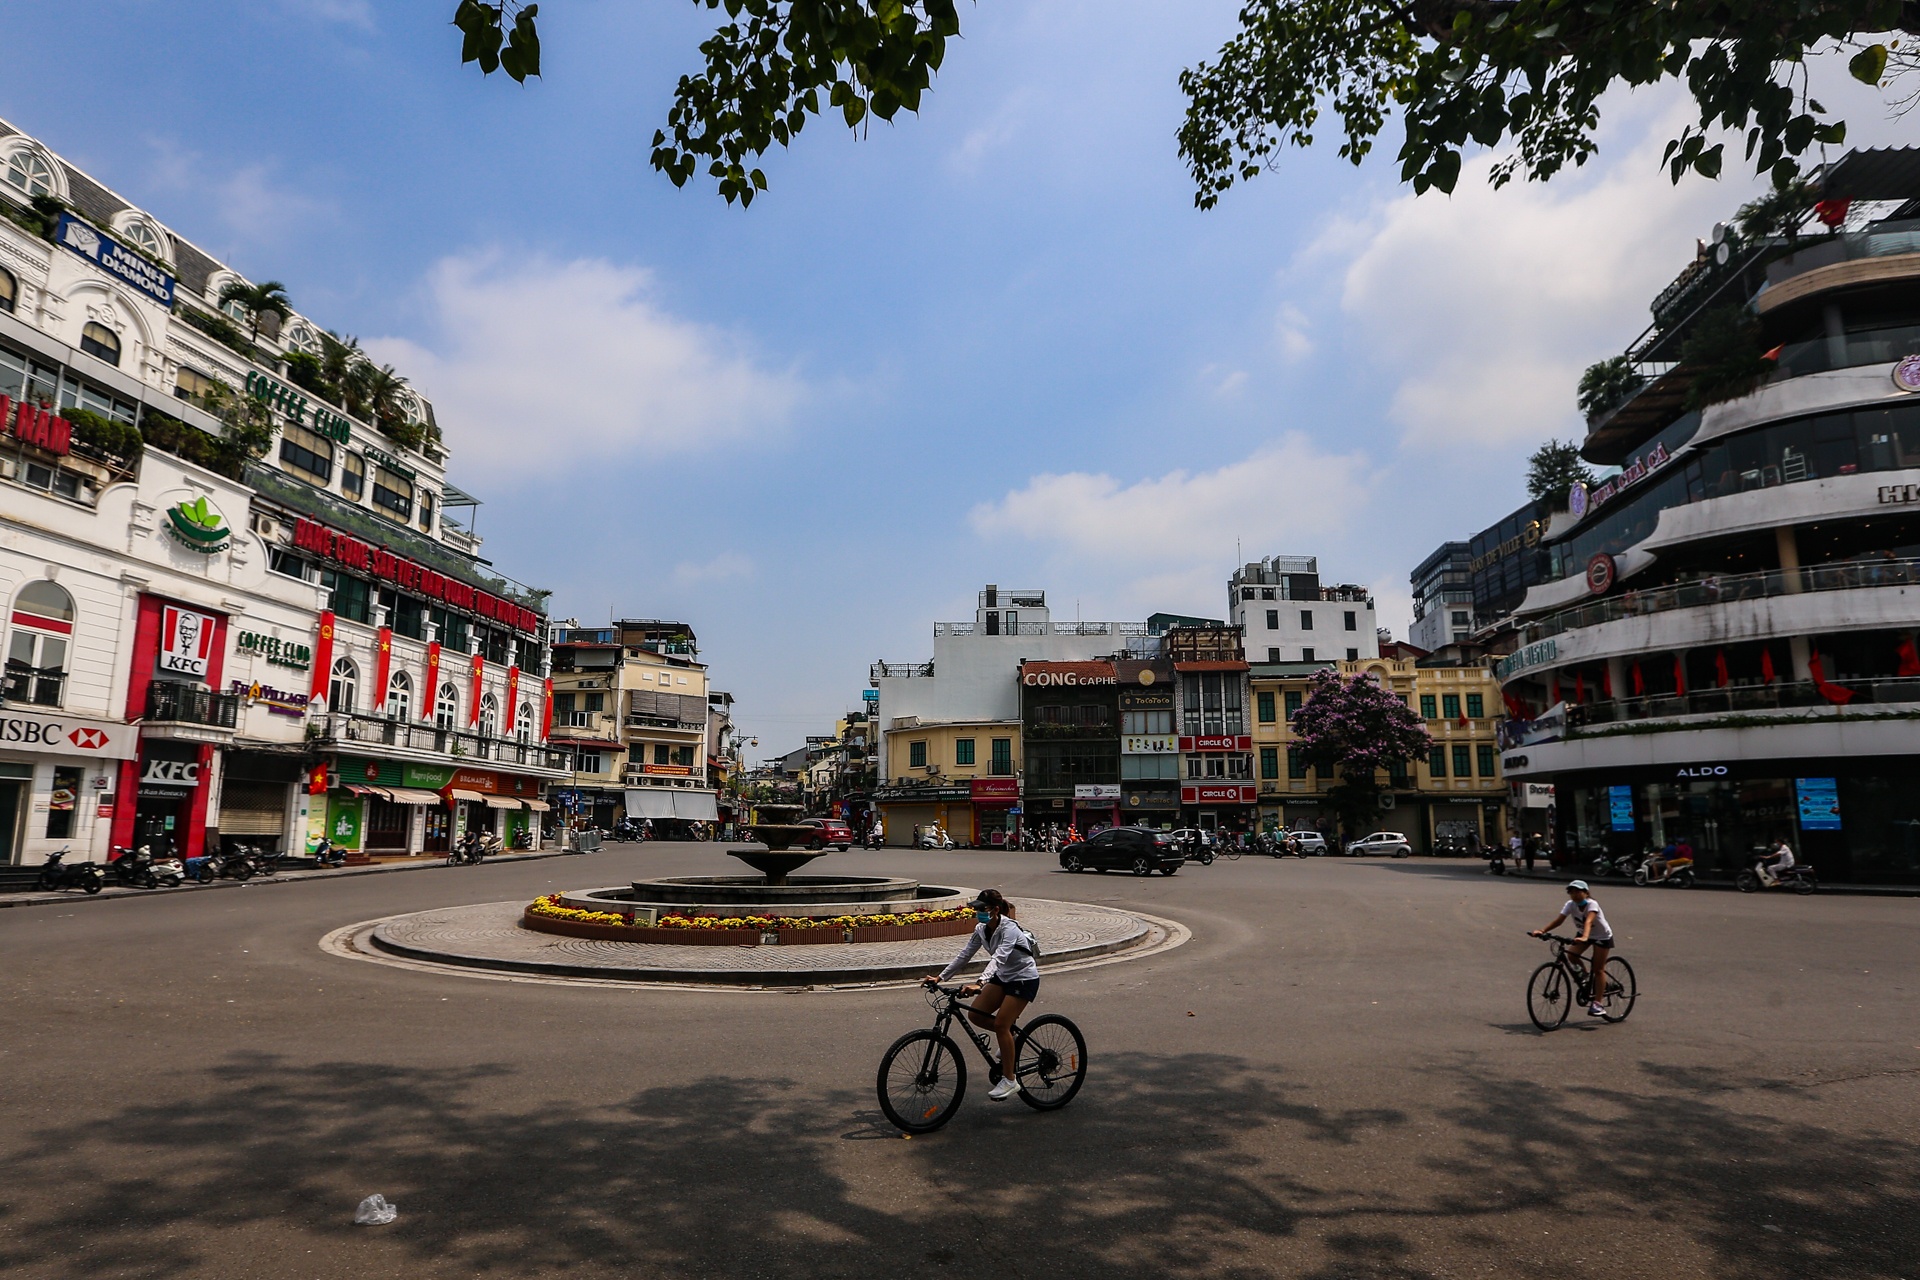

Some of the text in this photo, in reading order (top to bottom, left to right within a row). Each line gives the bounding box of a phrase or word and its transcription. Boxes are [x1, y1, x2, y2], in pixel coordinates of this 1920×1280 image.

[101, 253, 171, 301] DIAMOND
[112, 245, 166, 287] MINH
[245, 370, 351, 445] COFFEE CLUB
[1590, 481, 1617, 507] VUA
[238, 630, 281, 655] COFFEE
[283, 641, 310, 662] CLUB
[1523, 640, 1556, 666] BISTRO
[166, 655, 202, 673] KFC
[1024, 669, 1077, 689] CỘNG
[1198, 736, 1232, 748] CIRCLE K
[144, 759, 200, 781] KFC
[1504, 755, 1529, 769] ALDO
[1676, 765, 1728, 777] ALDO
[1226, 788, 1237, 799] K
